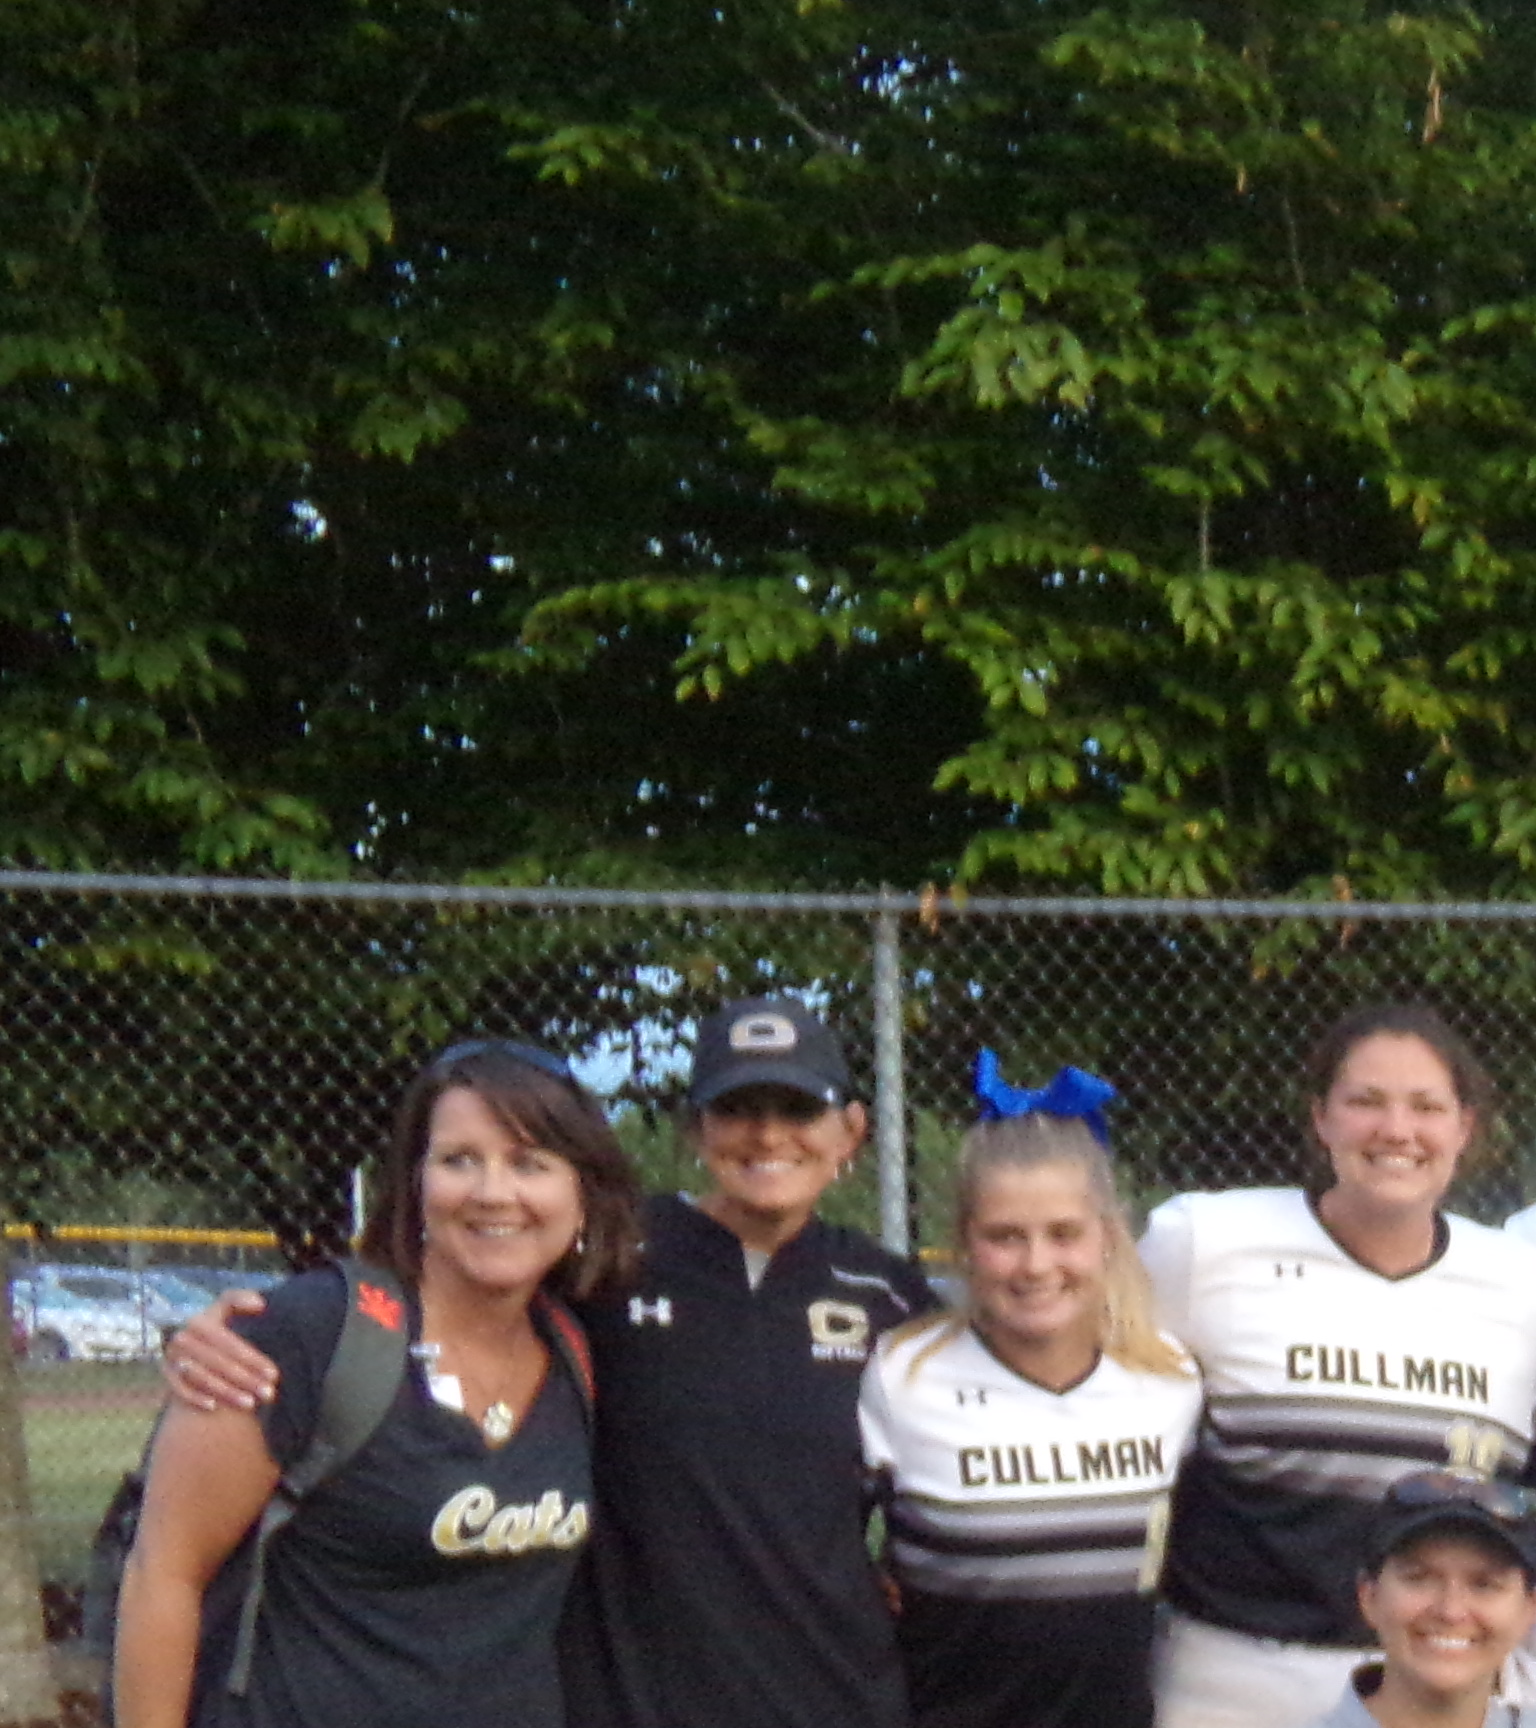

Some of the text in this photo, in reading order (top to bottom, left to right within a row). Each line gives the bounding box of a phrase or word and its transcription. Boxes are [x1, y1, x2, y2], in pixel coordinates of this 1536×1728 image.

[1285, 1344, 1488, 1404] CULLMAN
[958, 1436, 1165, 1489] CULLMAN
[430, 1485, 588, 1556] Cats
